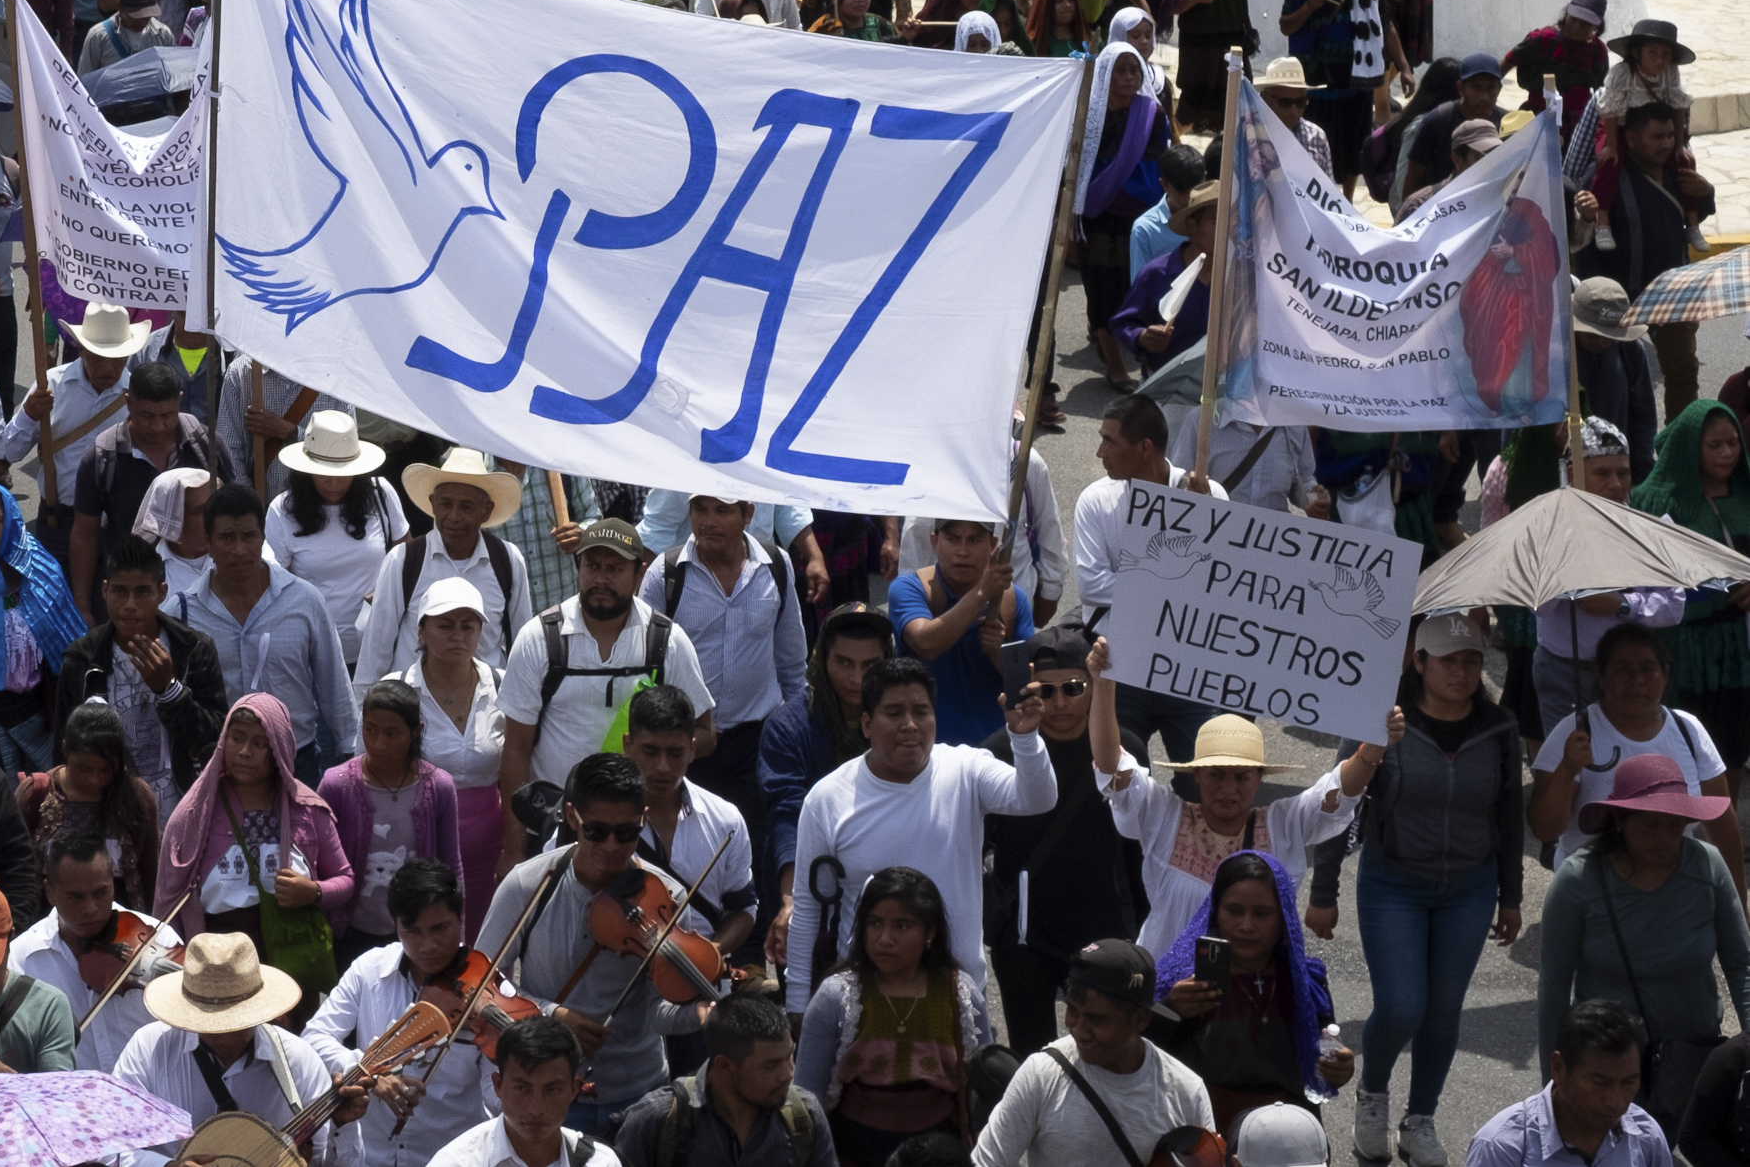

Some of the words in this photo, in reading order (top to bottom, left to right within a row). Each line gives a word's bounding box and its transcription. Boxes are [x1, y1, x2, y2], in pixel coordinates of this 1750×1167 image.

[52, 59, 81, 95] DEL
[60, 184, 114, 215] ENTRE
[119, 211, 186, 228] GENTE
[119, 201, 145, 214] LA
[148, 202, 196, 215] VIOL
[1426, 200, 1467, 223] CASAS
[61, 214, 84, 232] NO
[89, 226, 193, 254] QUEREMO
[54, 236, 147, 275] GOBIERNO
[154, 267, 190, 281] FED
[54, 250, 125, 287] NICIPAL,
[131, 277, 177, 292] QUE
[405, 52, 1015, 487] PAZ
[74, 279, 159, 303] CONTRA
[164, 295, 179, 304] A
[1267, 252, 1322, 300] SAN
[1323, 281, 1462, 321] ILDEFNSO
[1286, 296, 1361, 342] TENEJAPA,
[1366, 321, 1425, 341] CHIAPAS
[1263, 339, 1291, 358] ZONA
[1293, 349, 1314, 363] SAN
[1317, 356, 1363, 371] PEDRO,
[1367, 357, 1394, 371] SAN
[1399, 347, 1450, 365] PABLO
[1269, 385, 1371, 406] PEREGRINACIÓN
[1375, 397, 1397, 407] POR
[1401, 398, 1420, 408] LA
[1422, 397, 1449, 407] PAZ
[1322, 404, 1331, 415] Y
[1335, 405, 1353, 415] LA
[1354, 408, 1411, 417] JUSTICIA
[1126, 487, 1197, 534] PAZ
[1203, 508, 1232, 544] Y
[1228, 517, 1394, 578] JUSTICIA
[1205, 560, 1306, 615] PARA
[1155, 599, 1366, 686] NUESTROS
[1145, 653, 1321, 726] PUEBLOS
